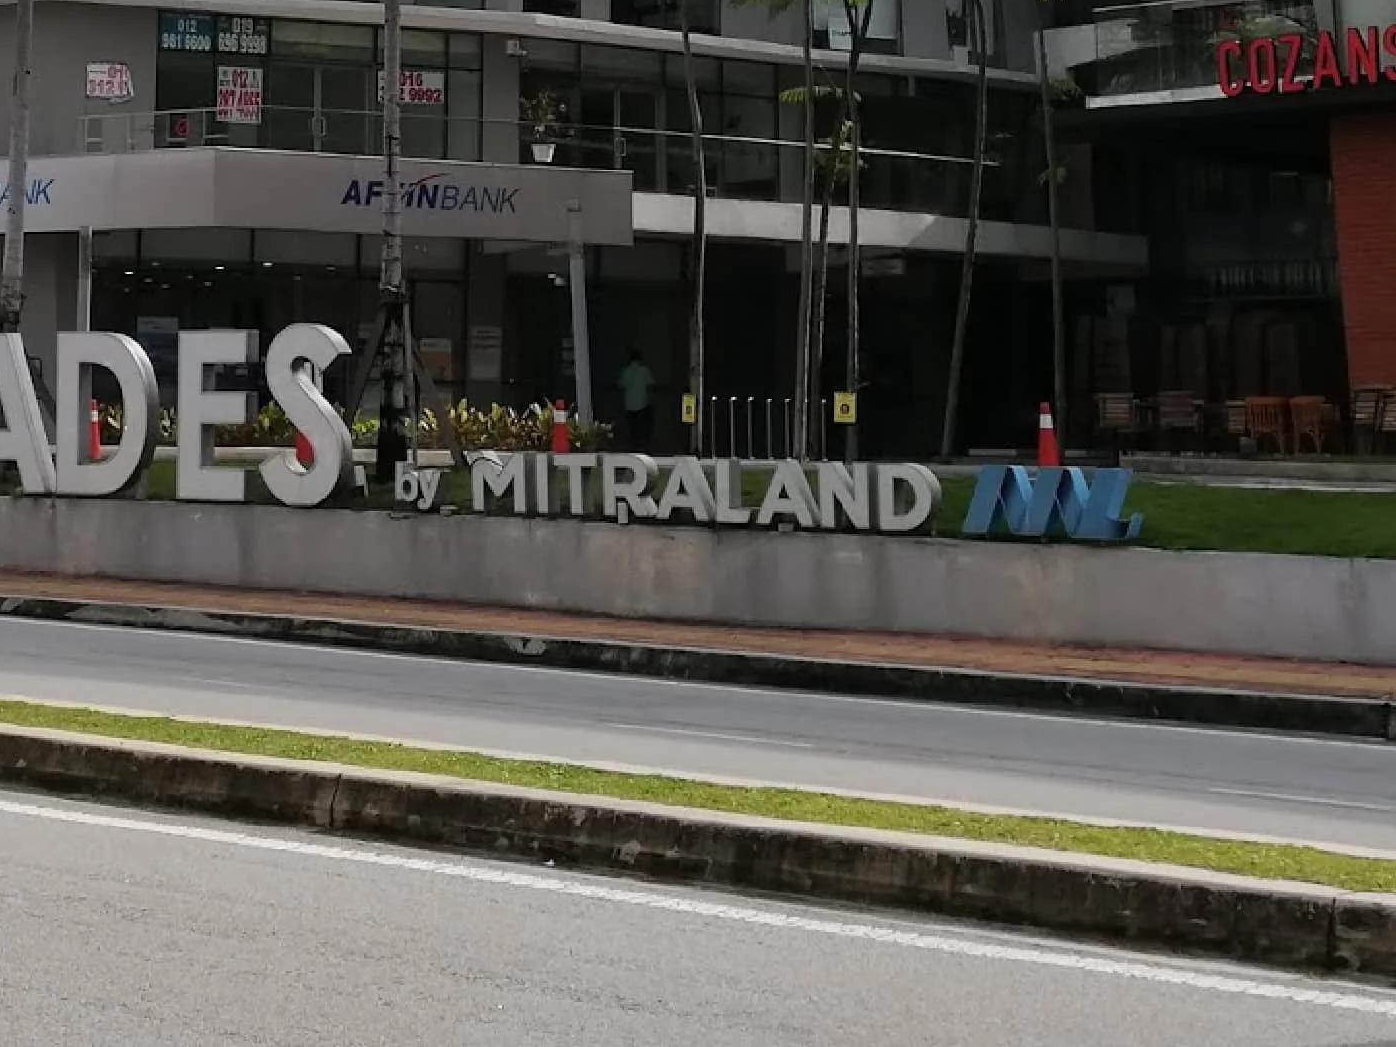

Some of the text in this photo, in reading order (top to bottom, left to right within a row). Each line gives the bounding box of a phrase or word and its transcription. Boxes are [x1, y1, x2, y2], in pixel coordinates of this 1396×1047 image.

[177, 19, 198, 33] 012
[394, 460, 443, 510] by
[466, 451, 942, 532] MITRALAND
